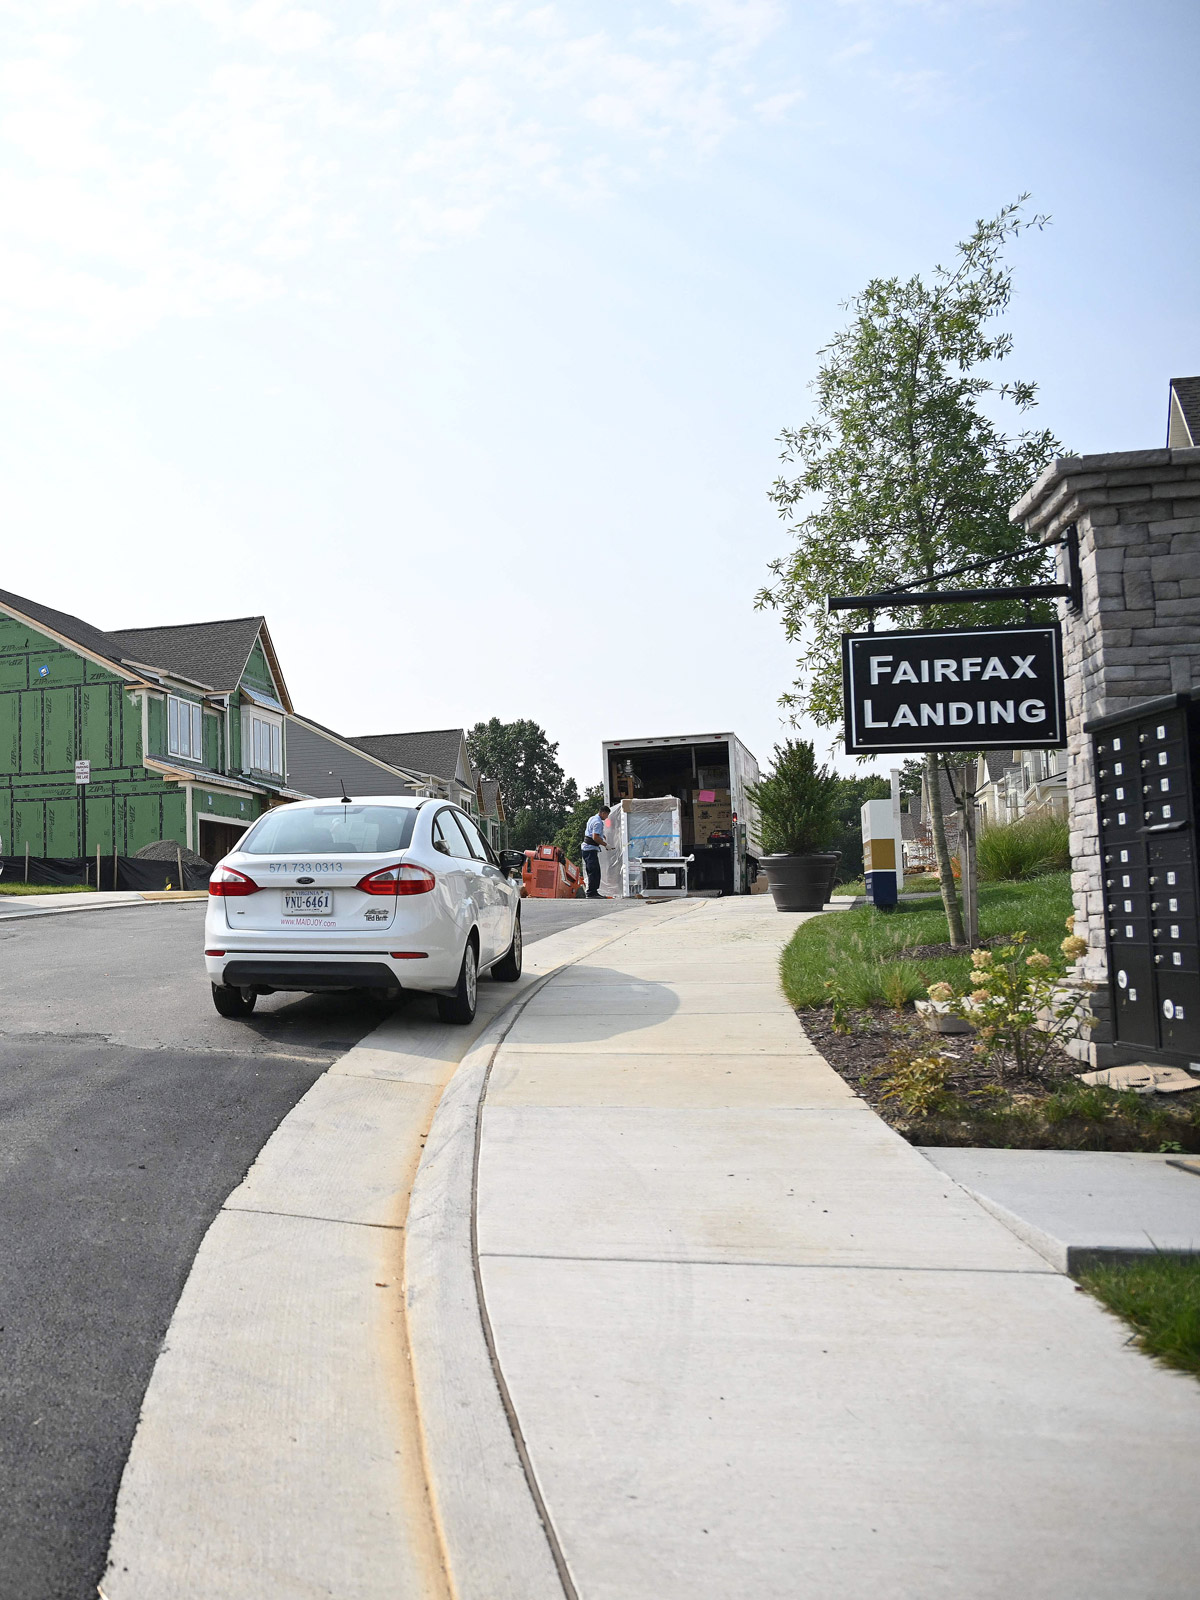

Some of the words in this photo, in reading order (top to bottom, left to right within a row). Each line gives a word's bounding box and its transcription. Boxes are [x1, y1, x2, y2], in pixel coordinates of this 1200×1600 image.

[870, 654, 1038, 686] FAIRFAX
[864, 698, 1046, 728] LANDING
[269, 862, 343, 873] 571.733.0313
[285, 896, 329, 908] VNU-6461
